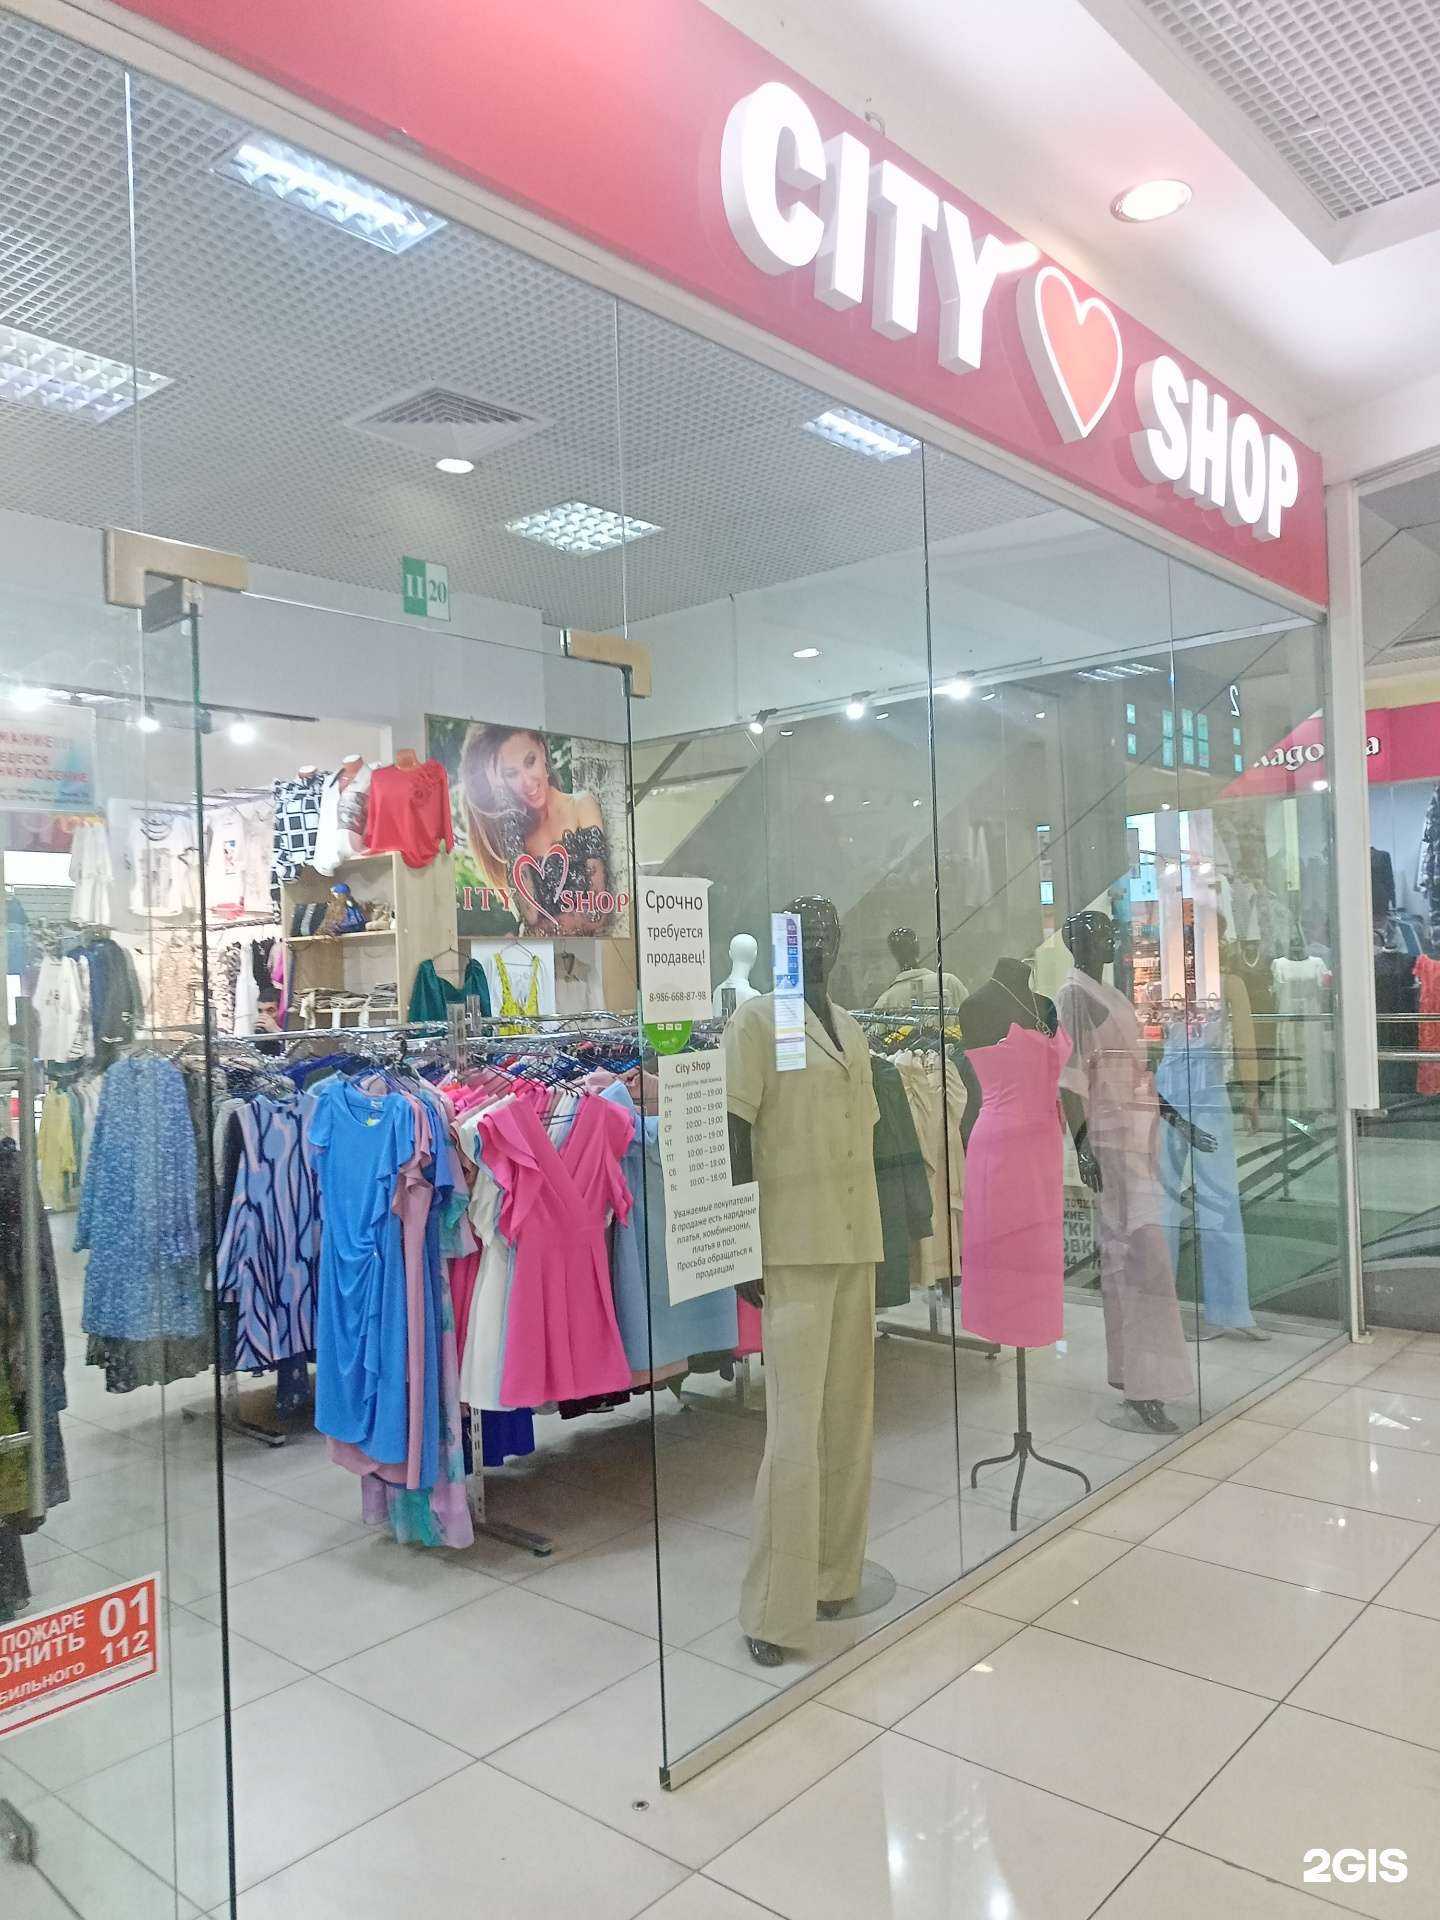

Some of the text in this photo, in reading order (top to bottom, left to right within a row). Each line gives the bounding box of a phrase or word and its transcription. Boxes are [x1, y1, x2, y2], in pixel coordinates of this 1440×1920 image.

[722, 82, 1298, 541] CITY SHOP
[456, 887, 630, 914] ITY SHOP
[645, 890, 703, 914] Срочно
[647, 923, 703, 941] требуется
[646, 950, 705, 967] продавец!
[675, 1061, 711, 1075] City Shop
[673, 1204, 712, 1219] Уважаемые
[677, 1256, 706, 1271] Просьба
[707, 1248, 748, 1264] обращаться
[692, 1242, 715, 1254] платья
[99, 1586, 149, 1638] 01
[2, 1609, 86, 1655] ПОЖАРЕ
[101, 1630, 149, 1664] 112
